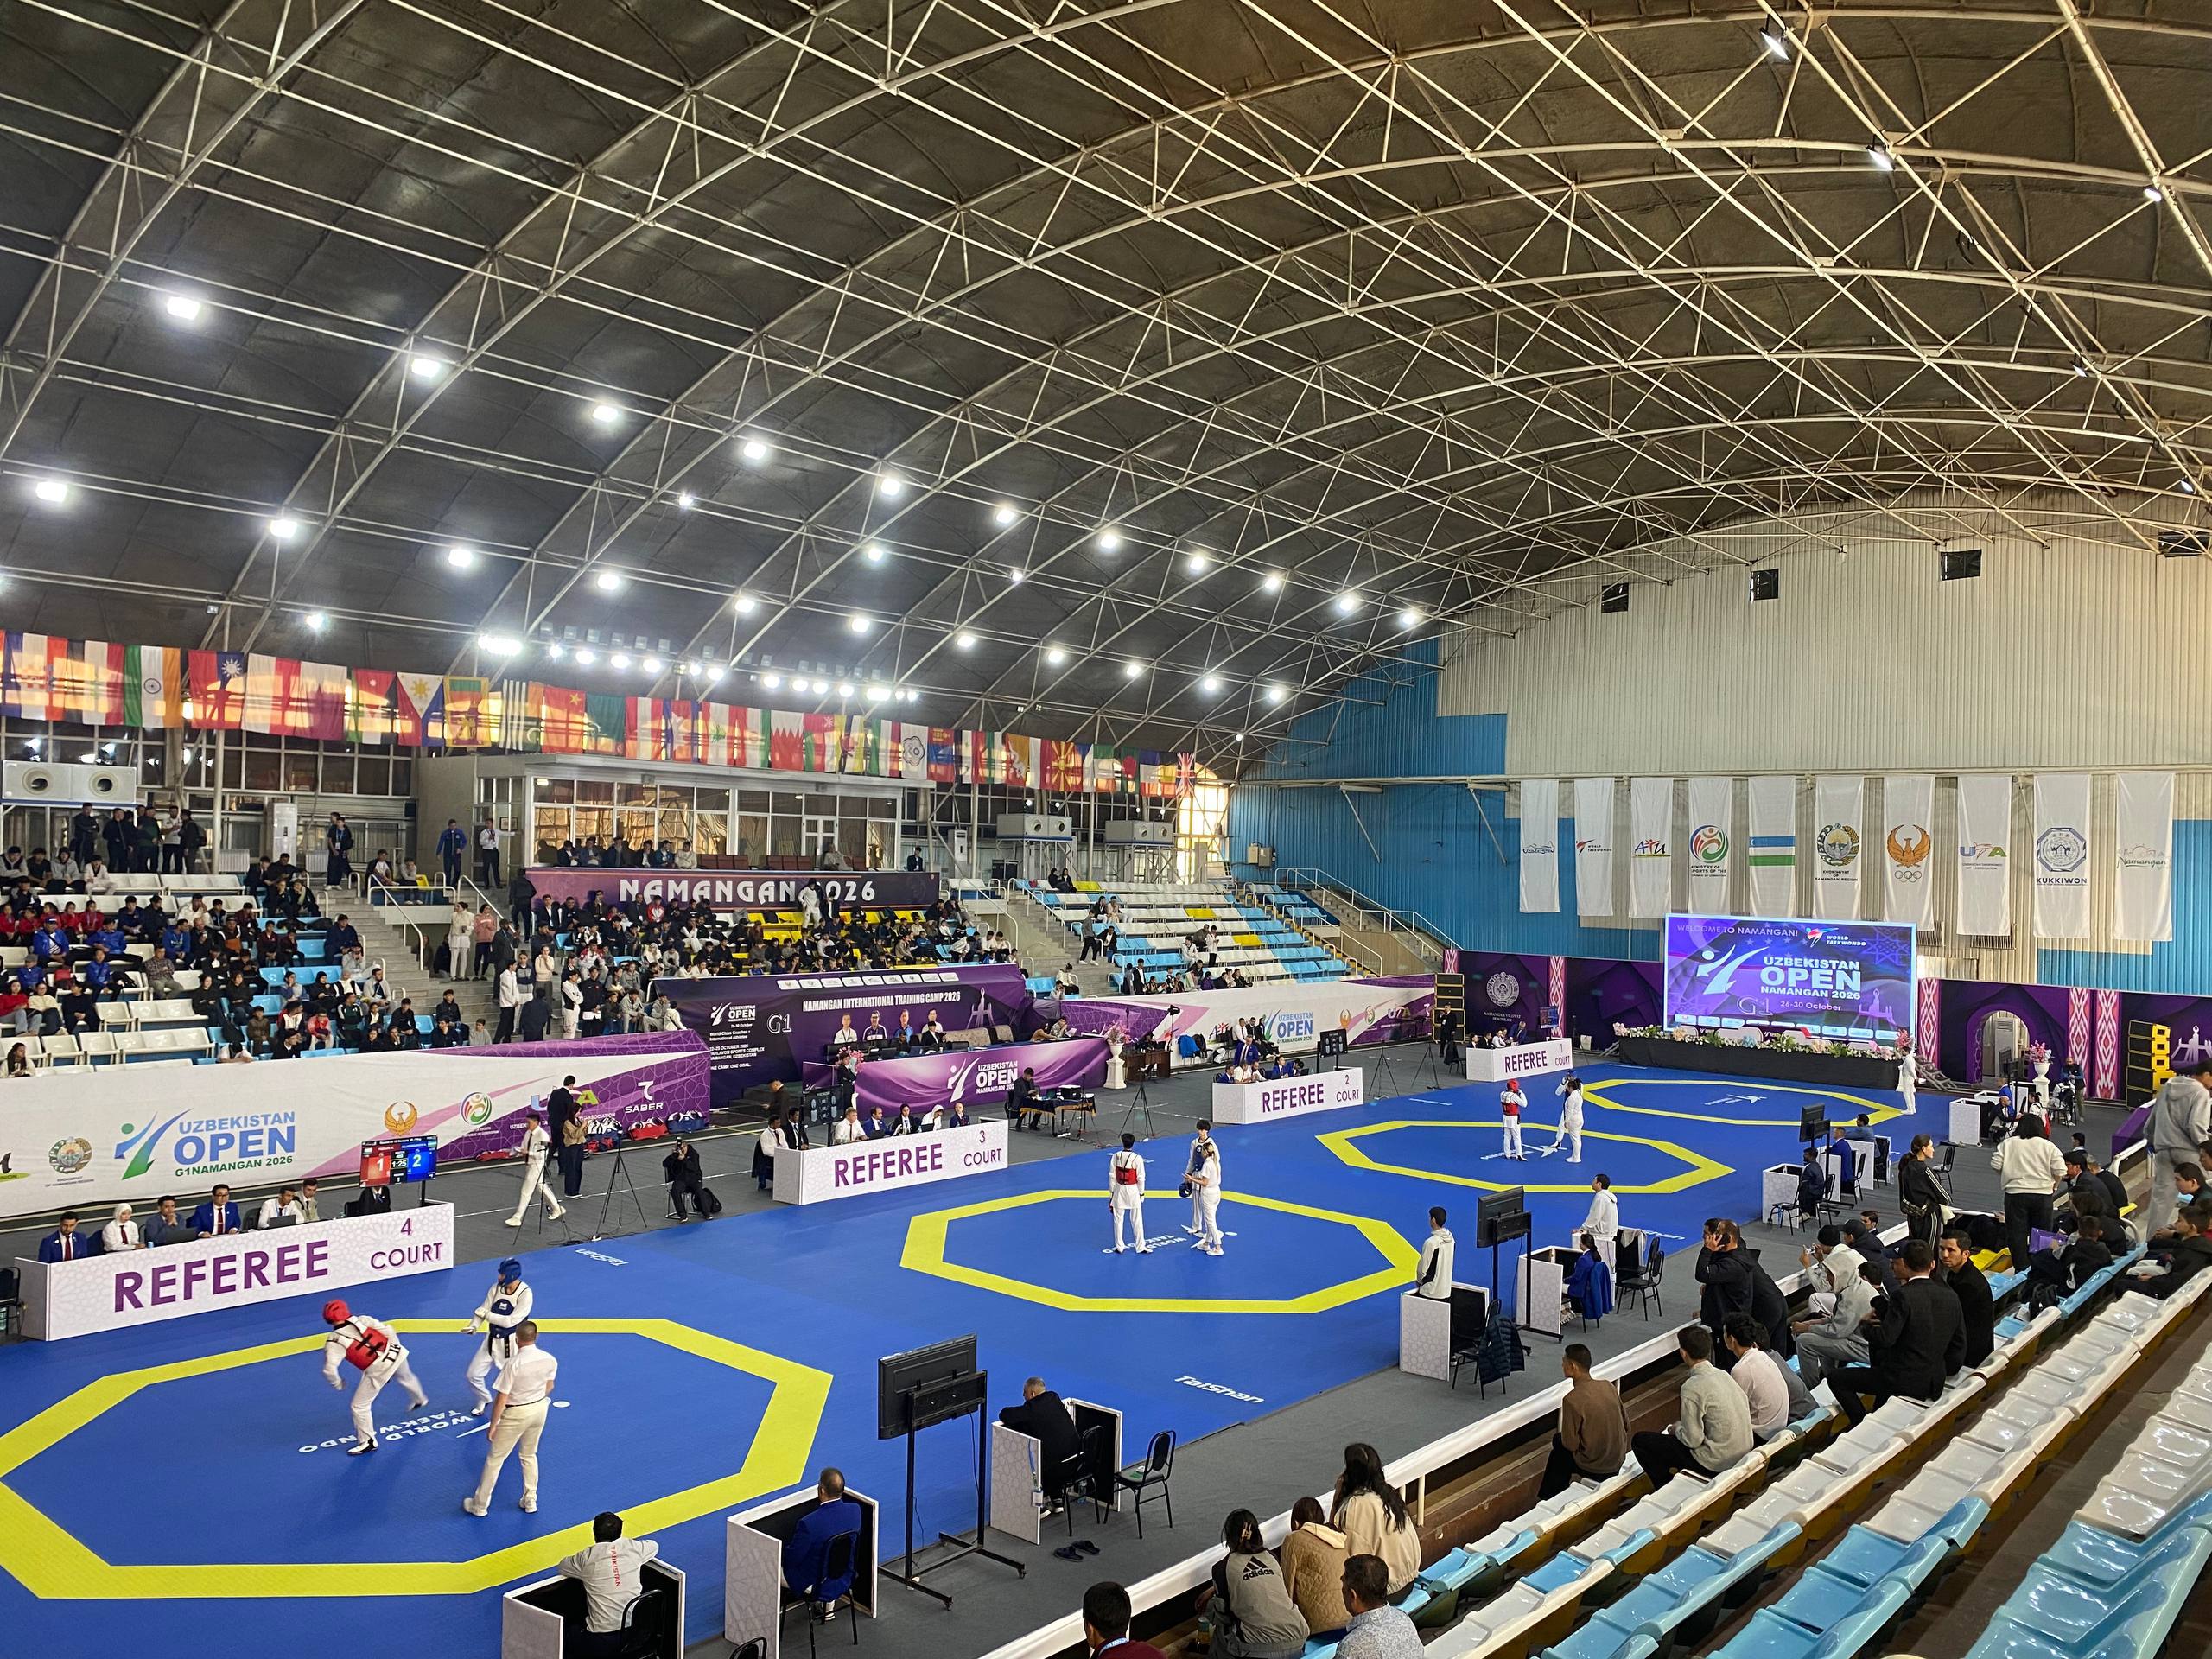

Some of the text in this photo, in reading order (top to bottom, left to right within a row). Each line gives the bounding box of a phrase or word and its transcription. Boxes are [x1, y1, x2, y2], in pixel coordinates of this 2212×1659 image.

[619, 880, 875, 904] NAMANGAN 026
[1677, 925, 1798, 937] WELCOME TO NAMANGAN!
[1764, 957, 1860, 970] UZBEKISTAN
[1760, 967, 1861, 992] OPEN
[803, 991, 961, 1012] NAMANGAN INTERNATIONAL TRAINING CAMP 2026
[1760, 986, 1861, 1001] NAMANGAN 2026
[728, 1009, 756, 1019] OPEN
[1780, 1001, 1842, 1011] 26-30 October
[1277, 1020, 1313, 1039] OPEN
[978, 1060, 1018, 1071] UZBEKISTAN
[1504, 1050, 1548, 1073] REFEREE
[1554, 1055, 1570, 1066] COURT
[976, 1068, 1018, 1088] OPEN
[1344, 1074, 1350, 1084] 2
[976, 1085, 1006, 1094] NAMANGAN
[1262, 1083, 1325, 1113] REFEREE
[1336, 1089, 1359, 1103] COURT
[625, 1103, 664, 1114] SABER
[179, 1111, 296, 1134] UZBEKISTAN
[979, 1129, 986, 1143] 3
[174, 1125, 296, 1166] OPEN
[175, 1155, 293, 1177] G1NAMANGAN 2026
[377, 1158, 384, 1172] 1
[391, 1160, 407, 1168] 1:25
[412, 1154, 422, 1167] 2
[834, 1143, 943, 1188] REFEREE
[963, 1148, 1002, 1166] COURT
[400, 1217, 413, 1236] 4
[370, 1242, 442, 1270] COURT
[113, 1239, 329, 1313] REFEREE
[298, 1409, 461, 1453] TAEKWNDO
[385, 1414, 474, 1441] WORLD
[1242, 1567, 1275, 1582] adidas
